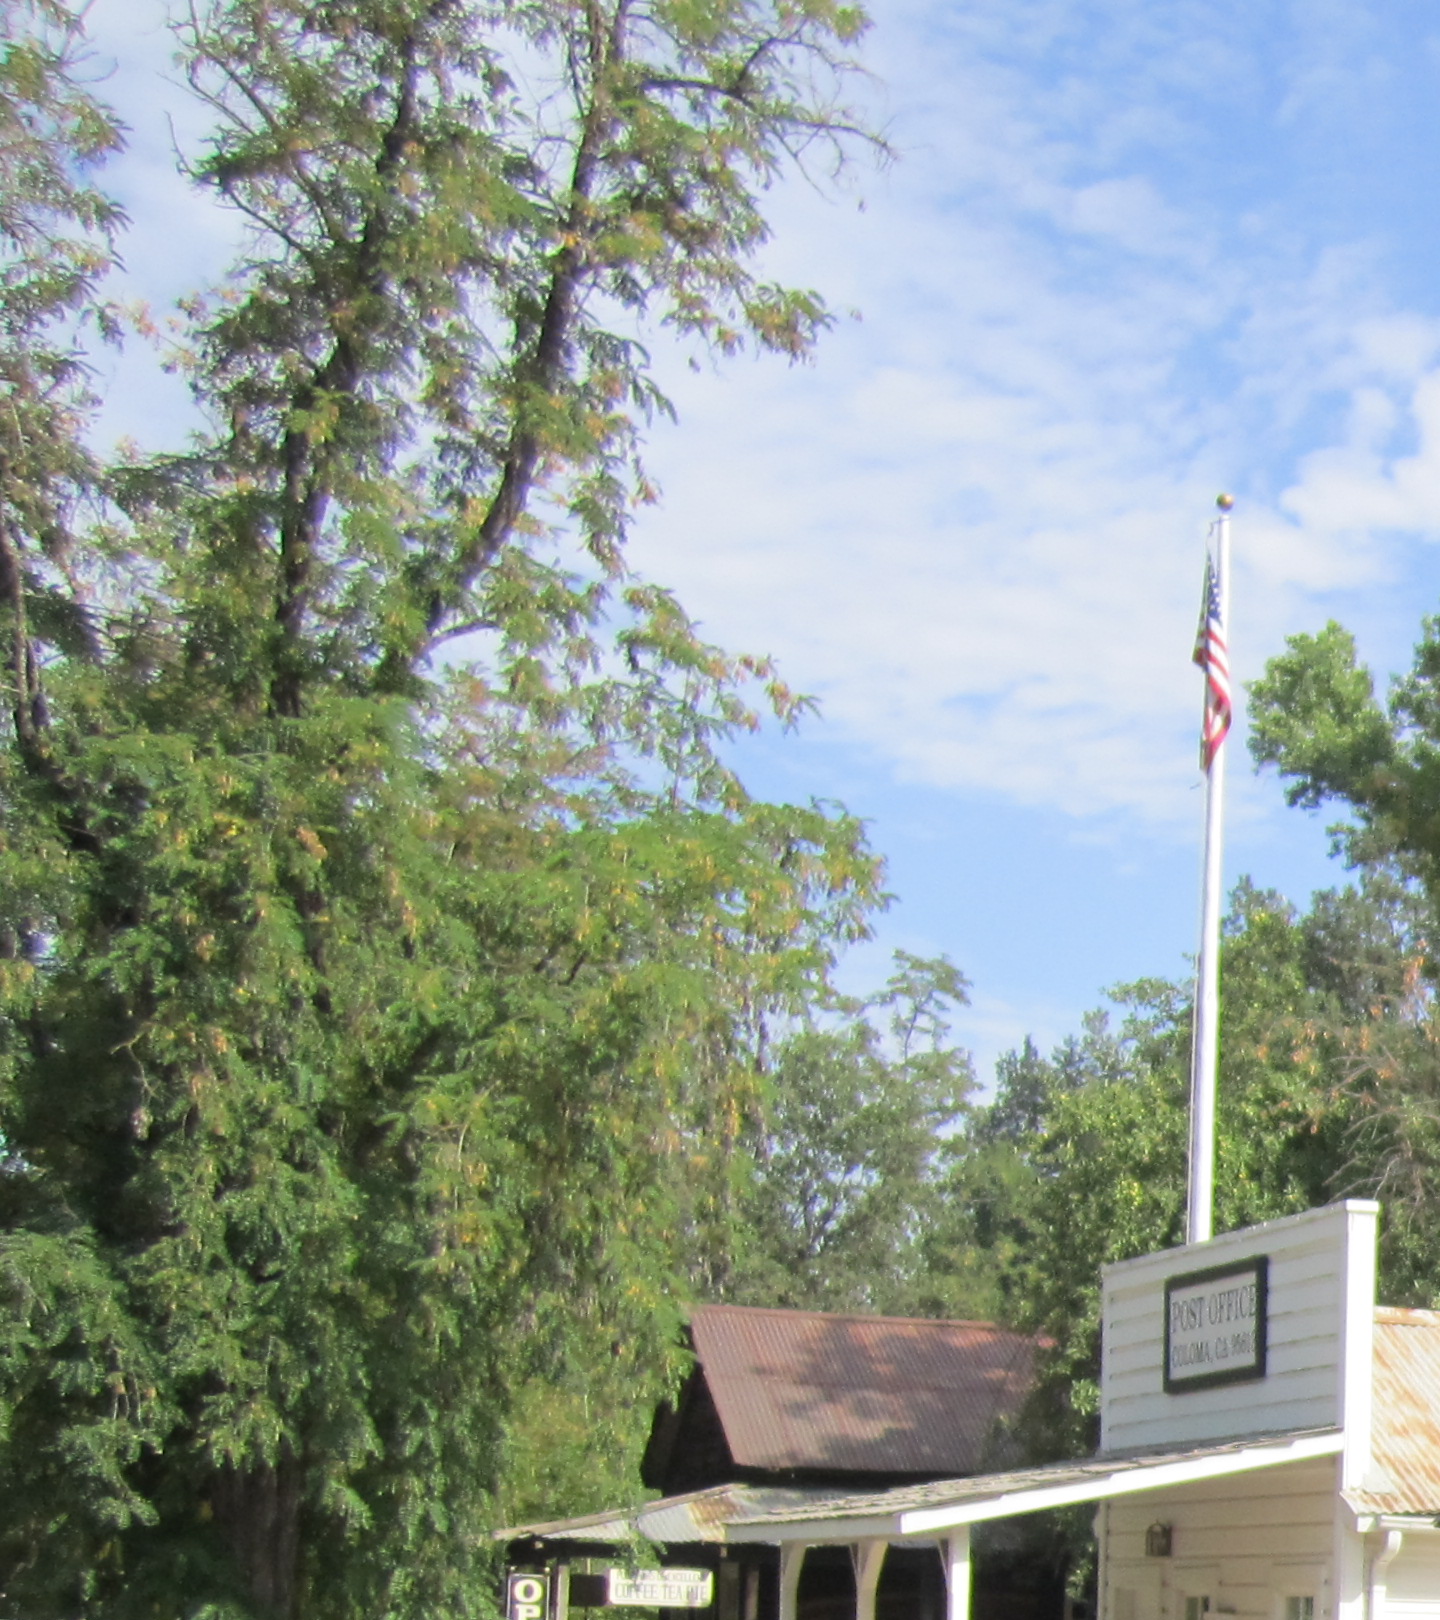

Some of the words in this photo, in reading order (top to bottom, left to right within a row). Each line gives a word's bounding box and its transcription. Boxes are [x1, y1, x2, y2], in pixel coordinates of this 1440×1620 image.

[1171, 1297, 1204, 1334] POST
[1208, 1285, 1256, 1325] OFFICE
[1172, 1341, 1213, 1368] COLOMA,
[1216, 1337, 1228, 1360] CA
[615, 1583, 658, 1599] COFFEE
[662, 1584, 683, 1601] TEA
